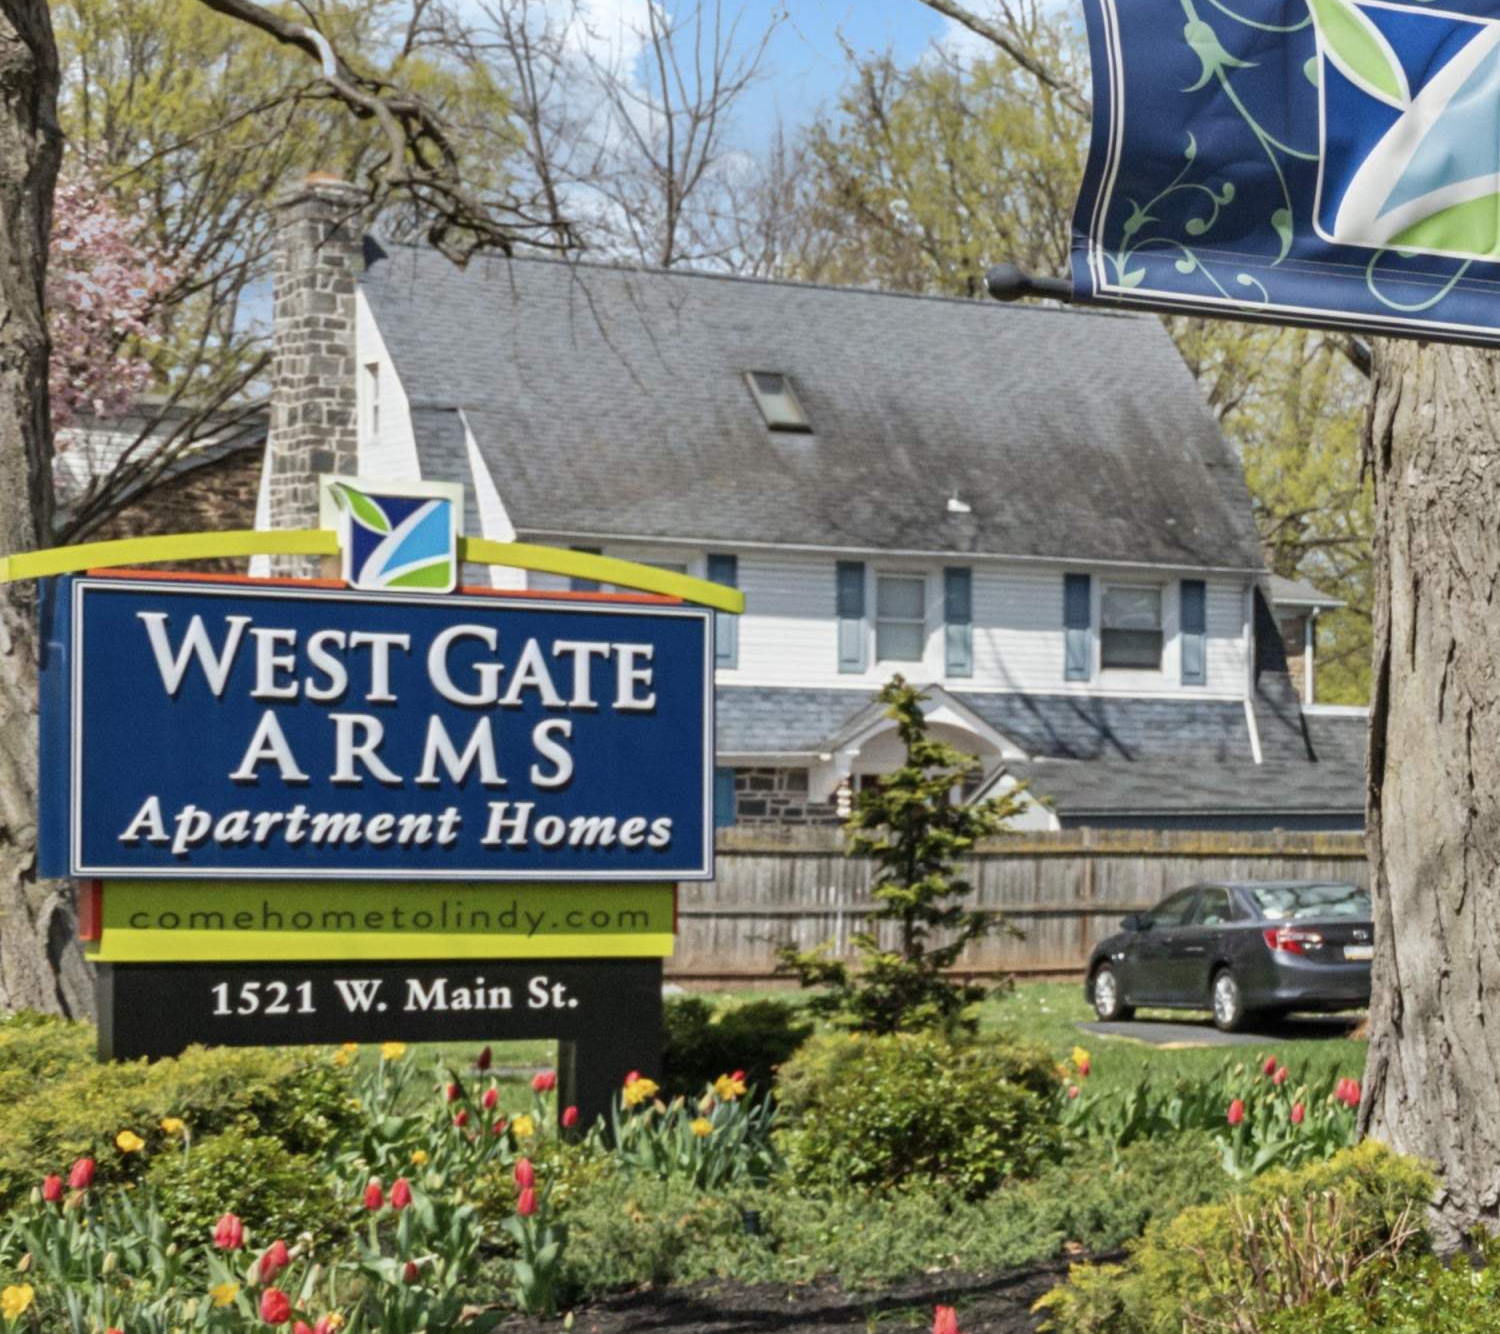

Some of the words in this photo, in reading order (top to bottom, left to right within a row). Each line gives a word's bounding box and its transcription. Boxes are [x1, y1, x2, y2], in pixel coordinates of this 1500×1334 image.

[136, 610, 411, 702] WEST
[426, 623, 657, 710] GATE
[229, 709, 575, 788] ARMS
[118, 795, 462, 854] Apartment
[481, 801, 673, 848] Homes
[129, 900, 651, 937] comehometolindy.com
[211, 981, 315, 1015] 1521
[334, 979, 387, 1012] W.
[403, 978, 514, 1011] Main
[526, 976, 580, 1009] St.
